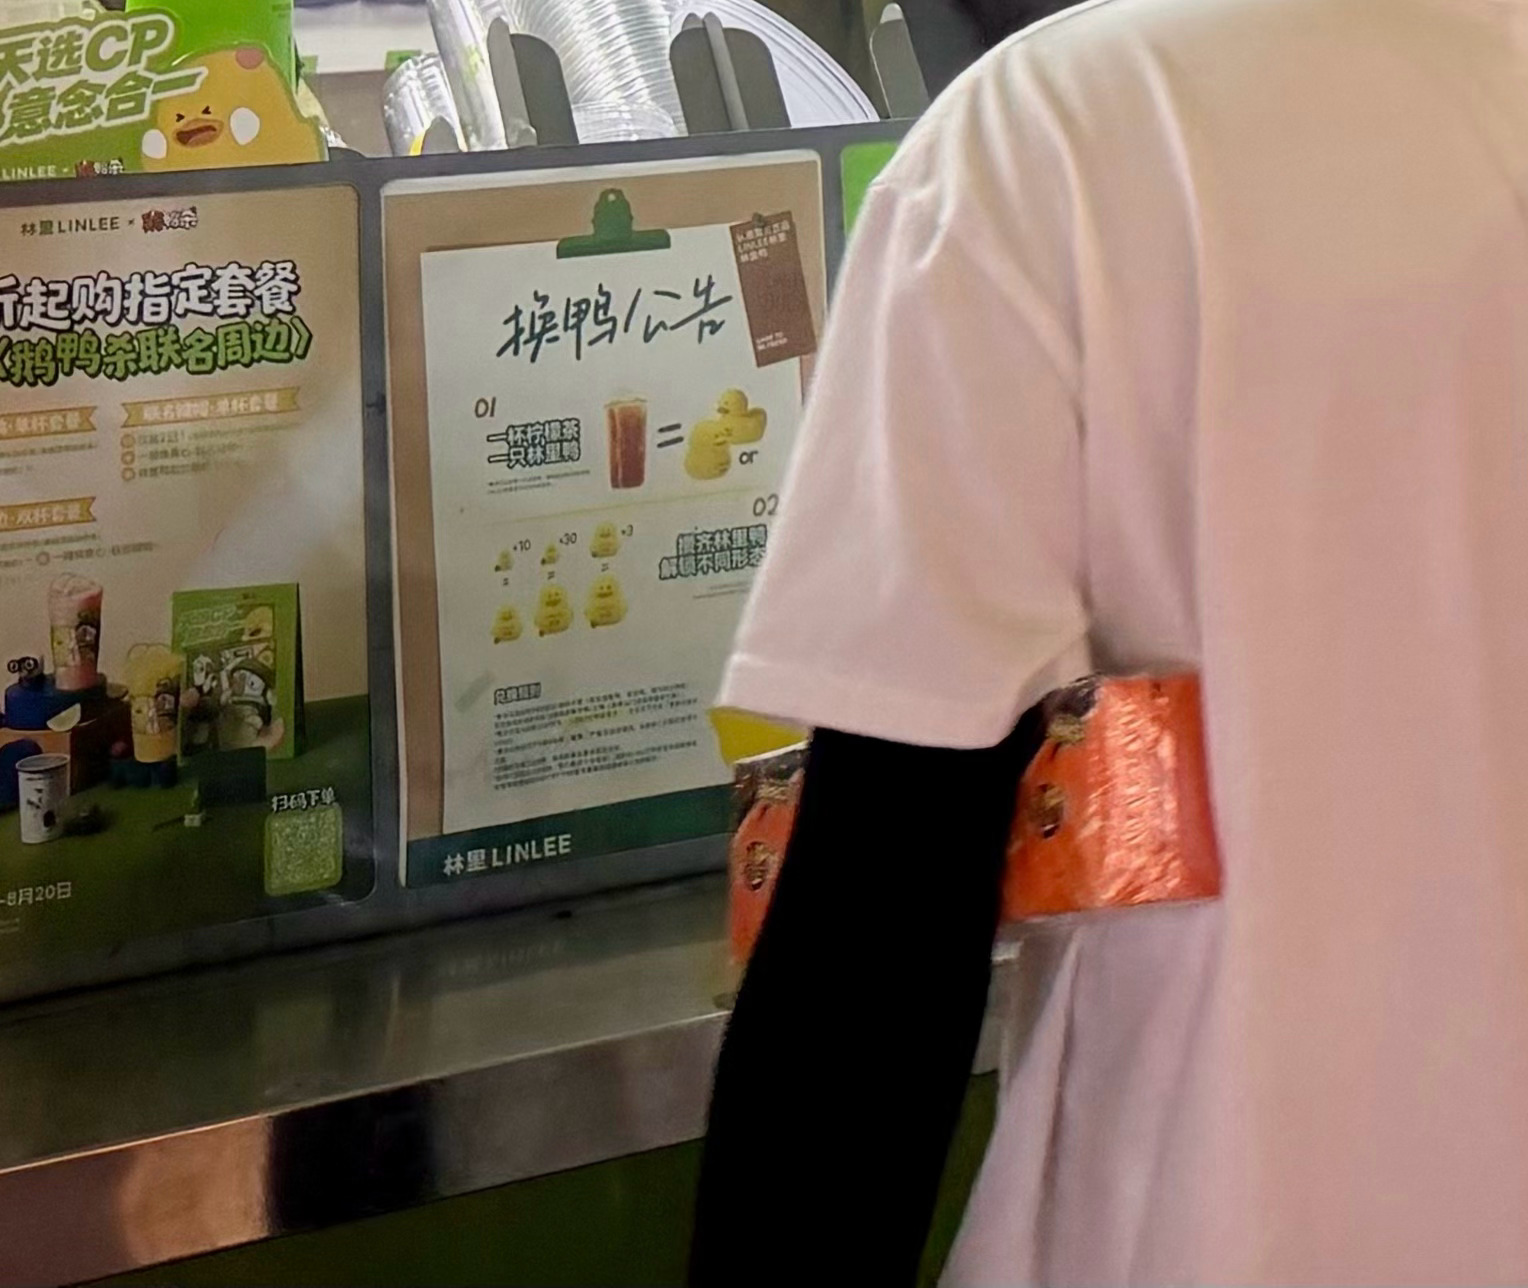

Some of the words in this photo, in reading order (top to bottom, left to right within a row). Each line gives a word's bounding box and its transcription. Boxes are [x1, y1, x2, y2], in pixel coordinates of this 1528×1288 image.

[496, 274, 733, 363] 换鸭公告
[738, 448, 759, 465] or
[271, 786, 337, 813] 扫码下单
